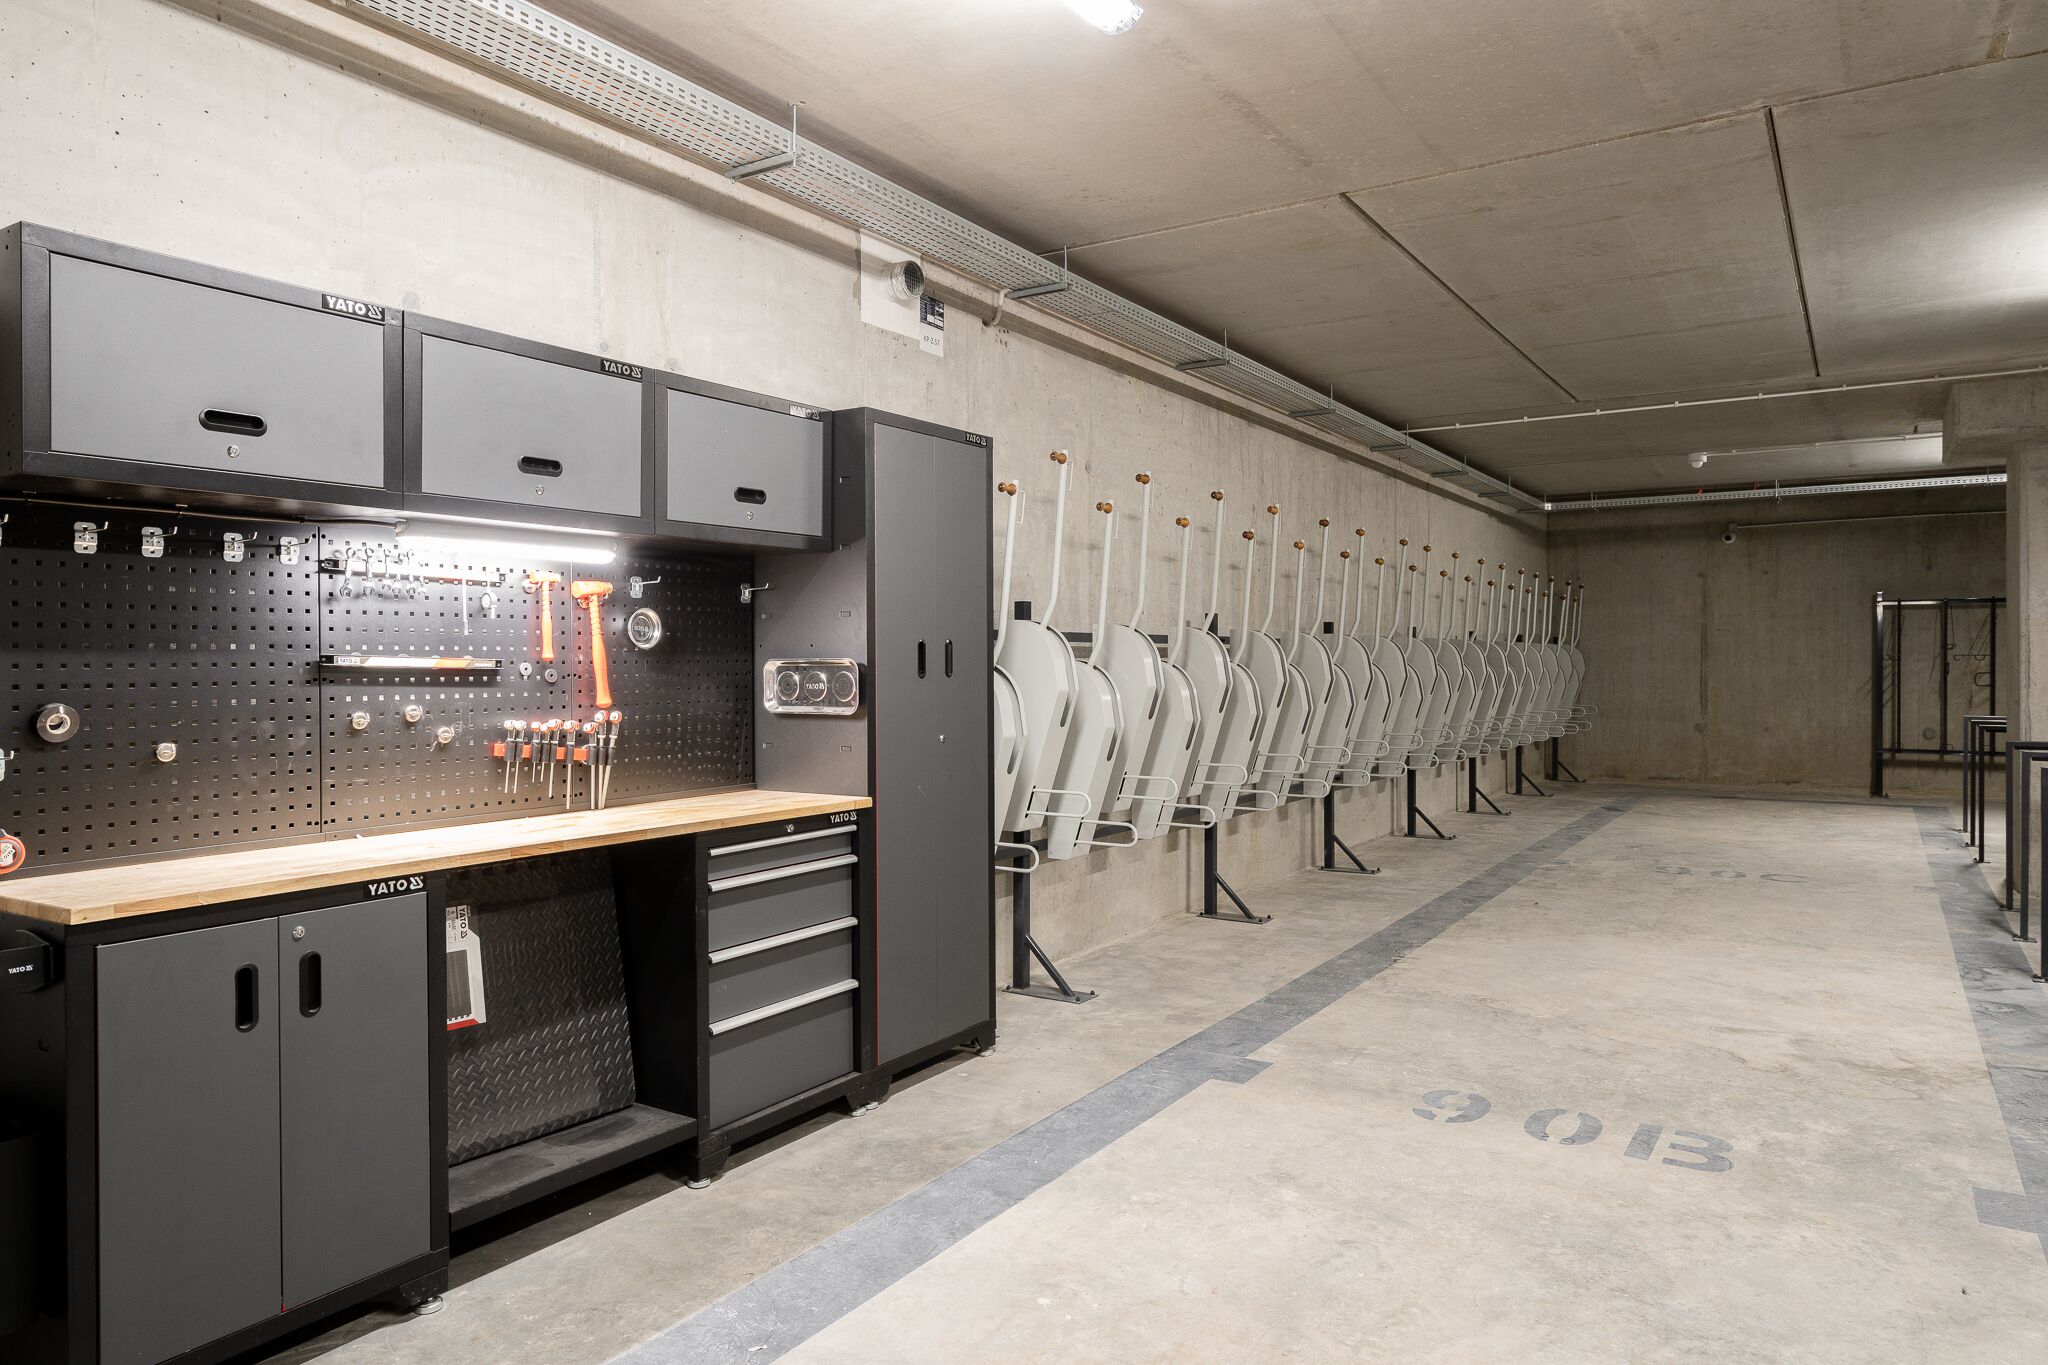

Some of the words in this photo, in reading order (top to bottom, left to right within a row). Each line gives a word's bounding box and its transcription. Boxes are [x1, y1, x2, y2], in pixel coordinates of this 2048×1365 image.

[326, 295, 367, 316] YATO
[603, 360, 631, 375] YATO
[966, 433, 981, 444] YATO
[830, 813, 849, 824] YATO
[1655, 866, 1809, 883] 90C
[368, 879, 408, 896] YATO
[459, 907, 467, 929] YATO
[8, 966, 26, 974] YATO
[1412, 1089, 1734, 1173] 90B
